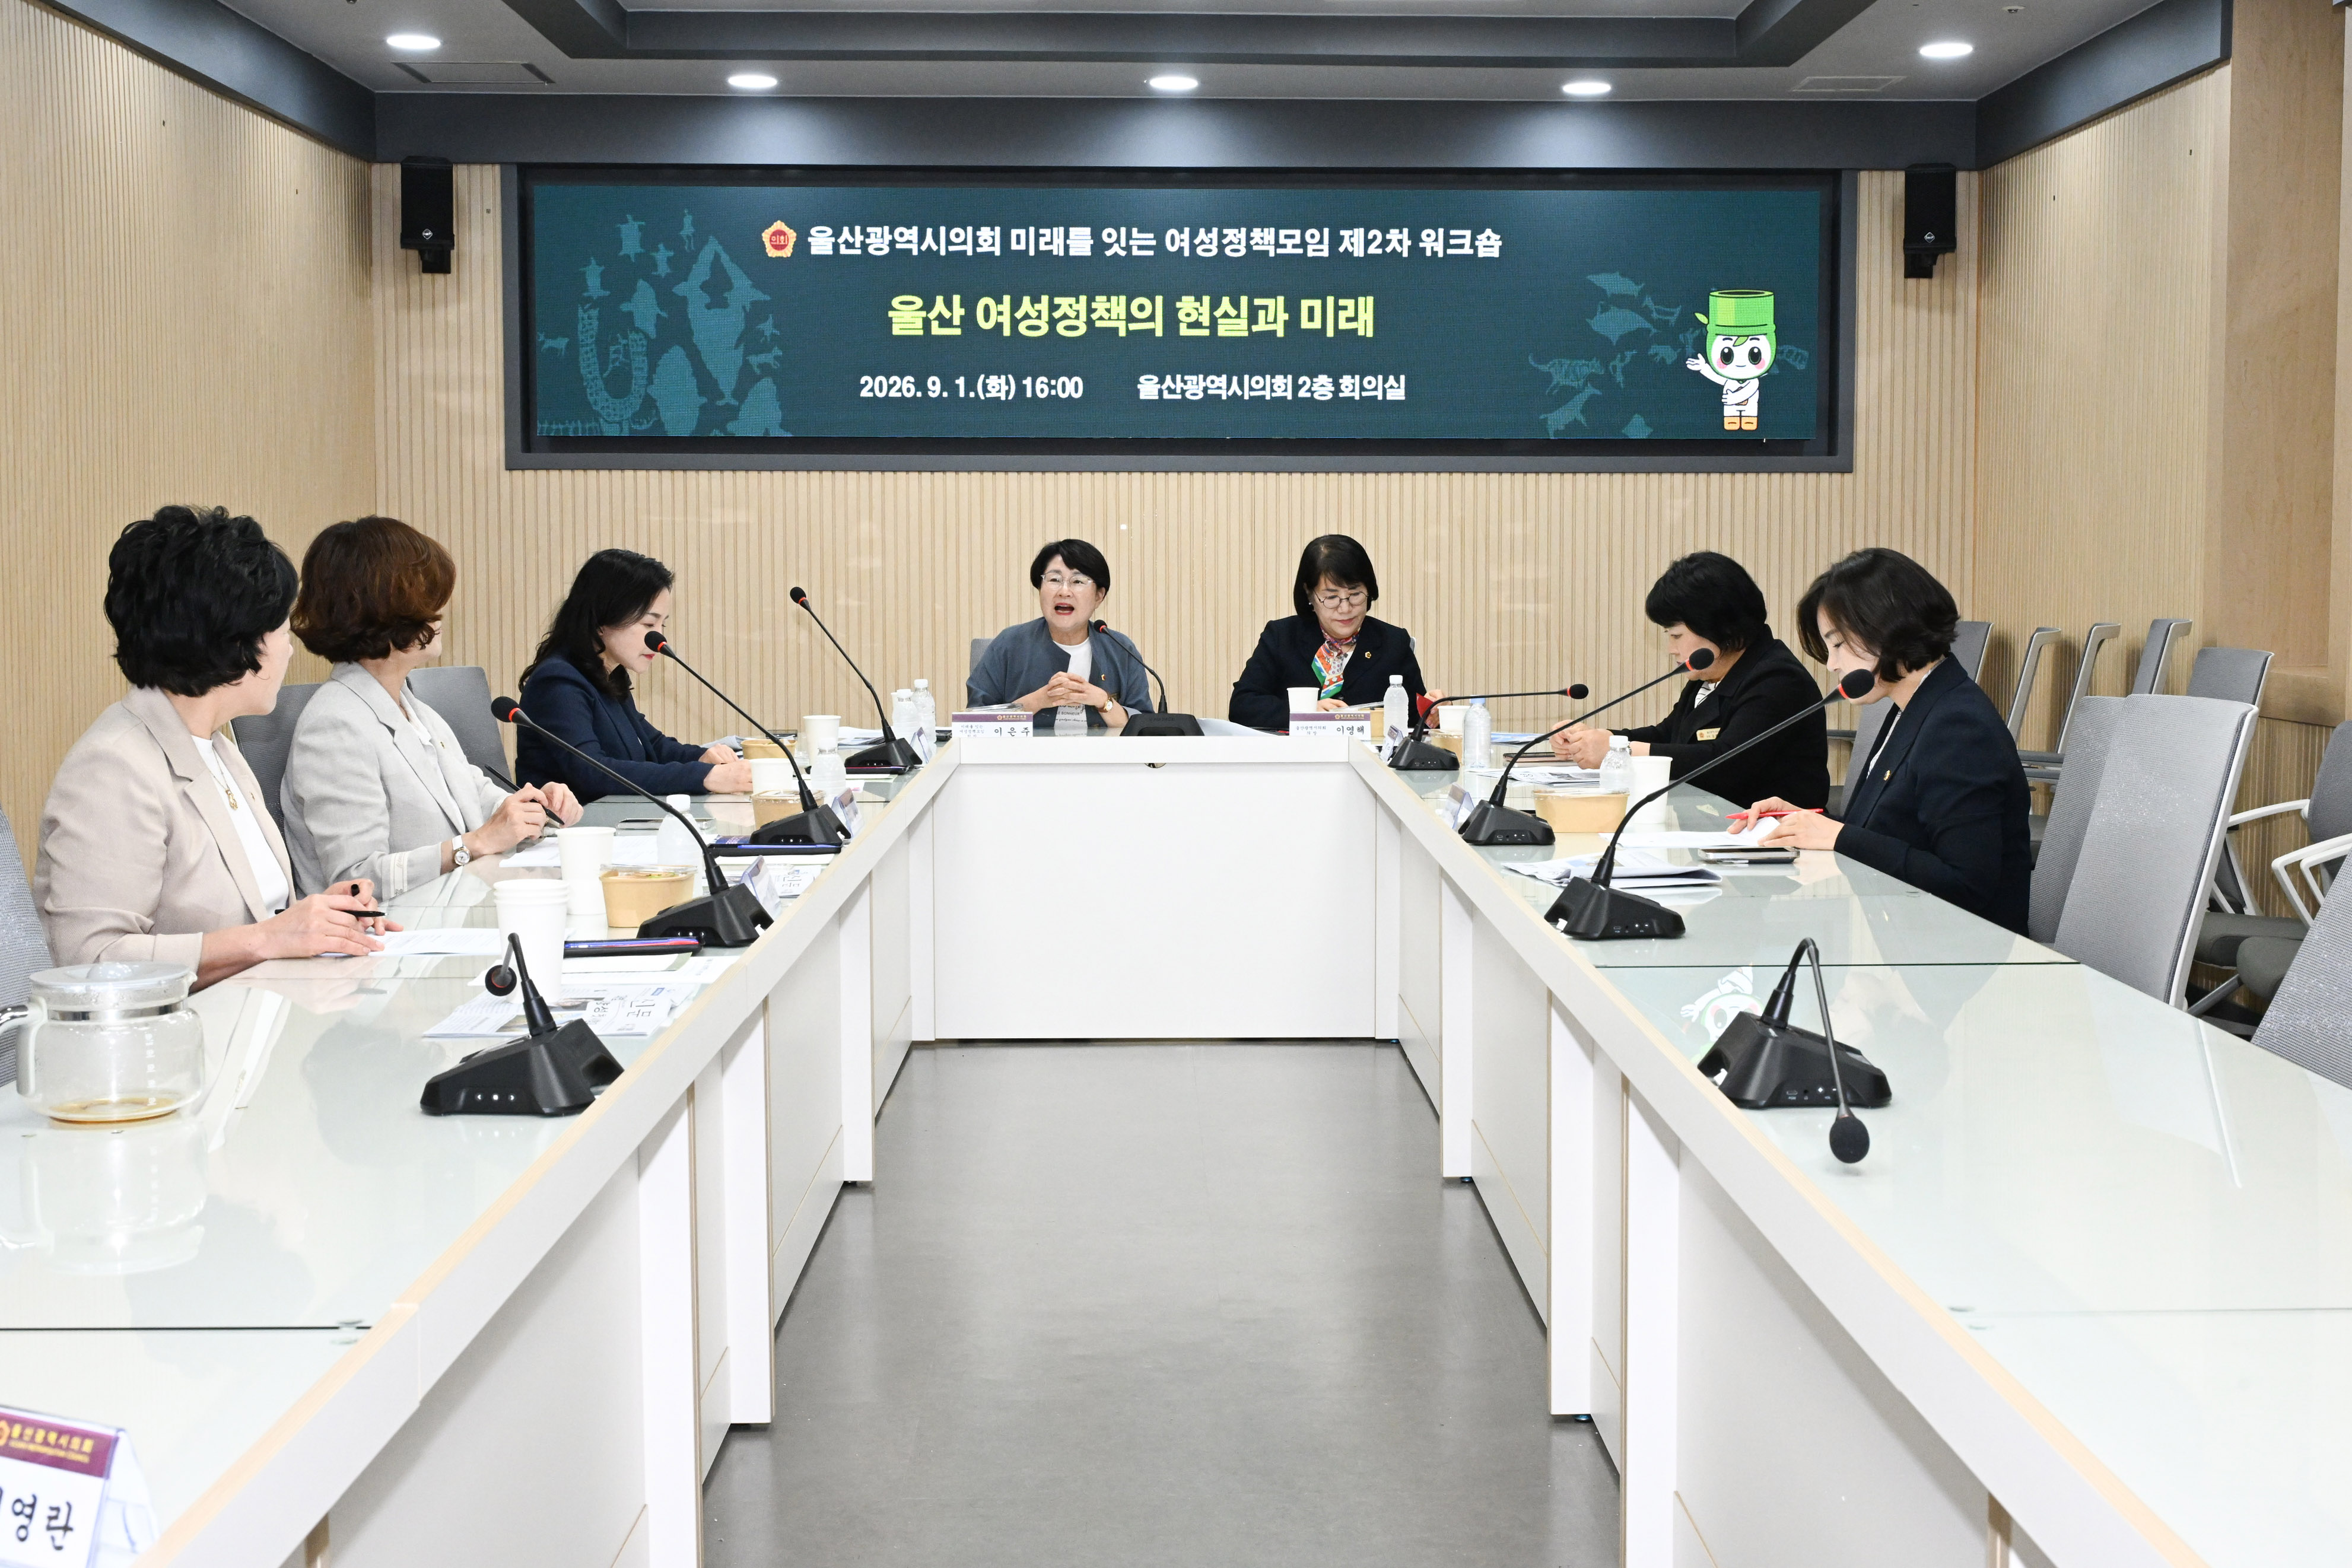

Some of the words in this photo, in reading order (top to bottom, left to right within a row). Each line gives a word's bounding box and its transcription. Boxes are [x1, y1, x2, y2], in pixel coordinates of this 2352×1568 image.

[770, 234, 788, 245] 의회
[808, 225, 1001, 256] 울산광역시의회
[1010, 226, 1094, 256] 미래를
[1101, 227, 1156, 257] 잇는
[1165, 227, 1329, 257] 여성정책모임
[1338, 227, 1412, 257] 제2차
[1419, 228, 1502, 257] 워크숍
[888, 294, 965, 336] 울산
[976, 295, 1163, 337] 여성정책의
[1175, 295, 1289, 338] 현실과
[1301, 295, 1374, 338] 미래
[1022, 376, 1083, 399] 16:00
[1137, 374, 1292, 400] 울산광역시의회
[1298, 374, 1335, 400] 2층
[1339, 374, 1406, 400] 회의실
[627, 999, 656, 1018] 신문
[0, 1486, 74, 1551] 영란
